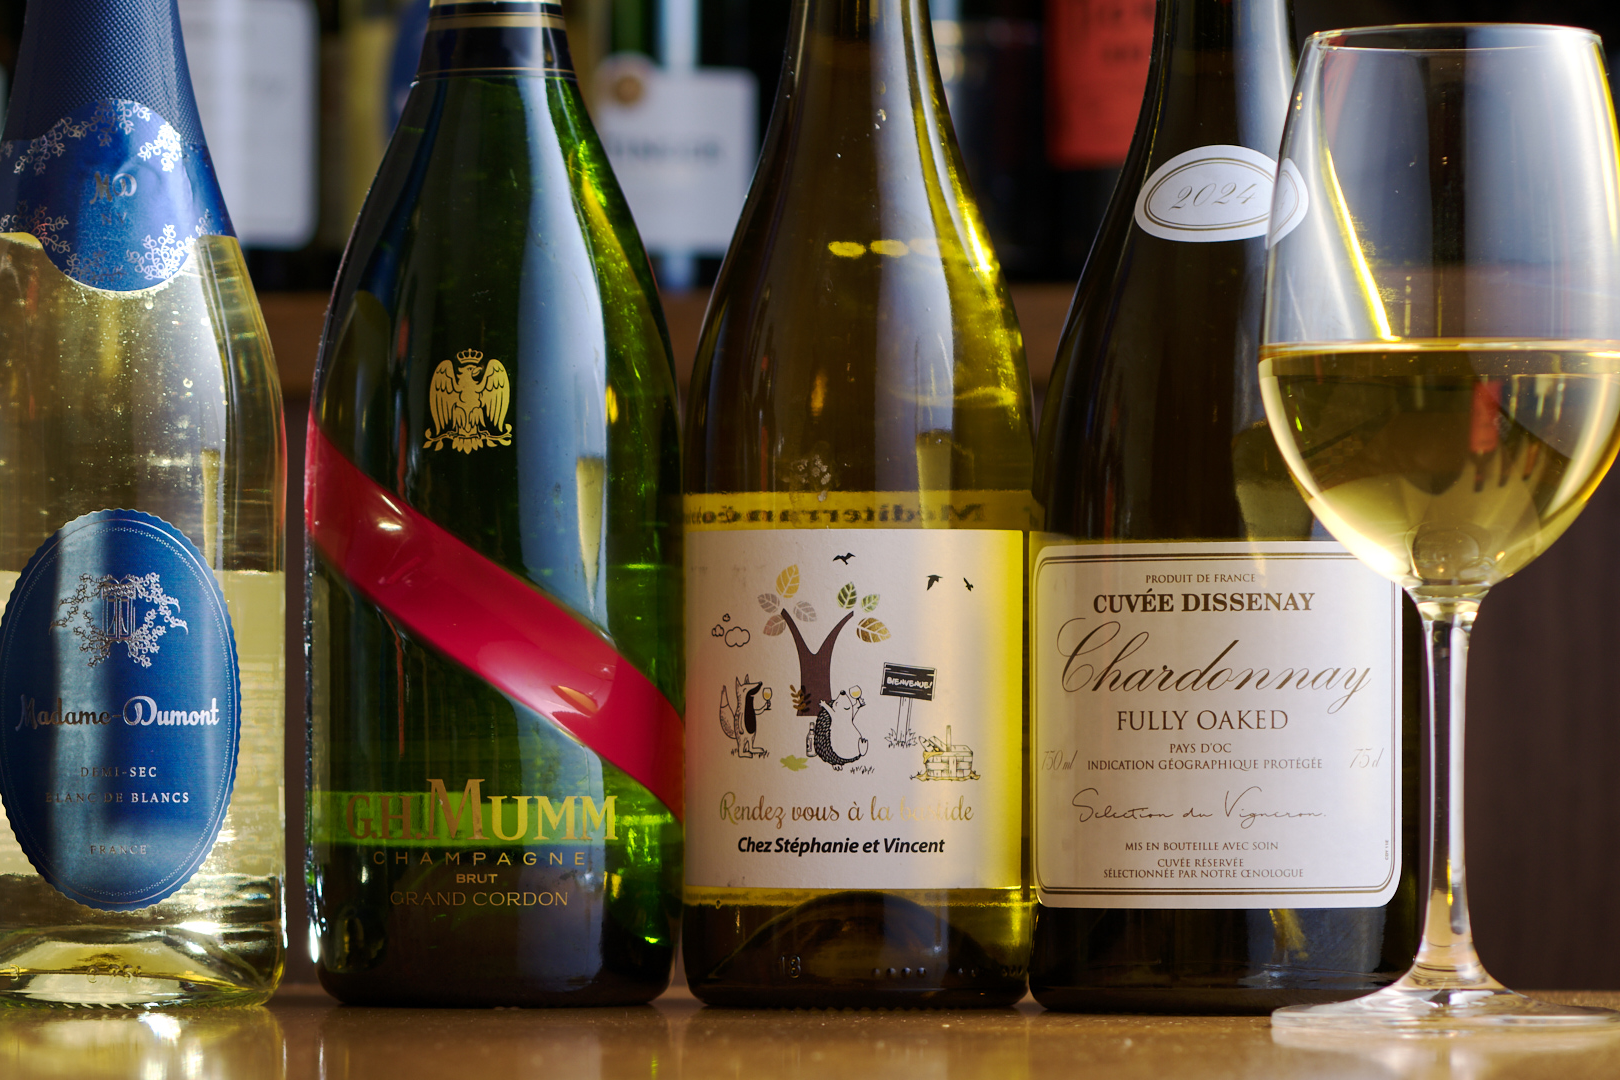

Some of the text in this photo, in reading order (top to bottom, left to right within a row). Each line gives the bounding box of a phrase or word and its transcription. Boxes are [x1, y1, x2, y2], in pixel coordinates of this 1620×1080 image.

[1168, 182, 1258, 211] 2024
[1145, 573, 1256, 584] PRODUIT DE FRANCE
[1093, 589, 1315, 613] CUVÉE DISSENAY
[1056, 617, 1371, 714] Chardonnay
[886, 677, 933, 690] BIENVENUE!
[1117, 709, 1289, 731] FULLY OAKED
[1170, 743, 1232, 754] PAYS D'OC
[1088, 757, 1323, 772] INDICATION GÉOGRAPHIQUE PROTÉGÉE
[80, 767, 157, 778] DEMI-SEC
[45, 791, 190, 803] BLANC DE BLANCS
[720, 791, 974, 829] Rendez vous à la bastide
[1182, 807, 1213, 818] du
[90, 845, 147, 854] FRANCE
[738, 836, 945, 857] Chez Stéphanie et Vincent
[1125, 842, 1279, 851] MIS EN BOUTEILLE AVEC SOIN
[373, 851, 586, 866] CHAMPAGNE
[1157, 857, 1244, 868] CUVÉE RÉSERVÉE
[456, 873, 498, 884] BRUT
[1103, 868, 1304, 879] SÉLECTIONNÉE PAR NOTRE ŒNOLOGUE
[390, 891, 568, 906] GRAND CORDON
